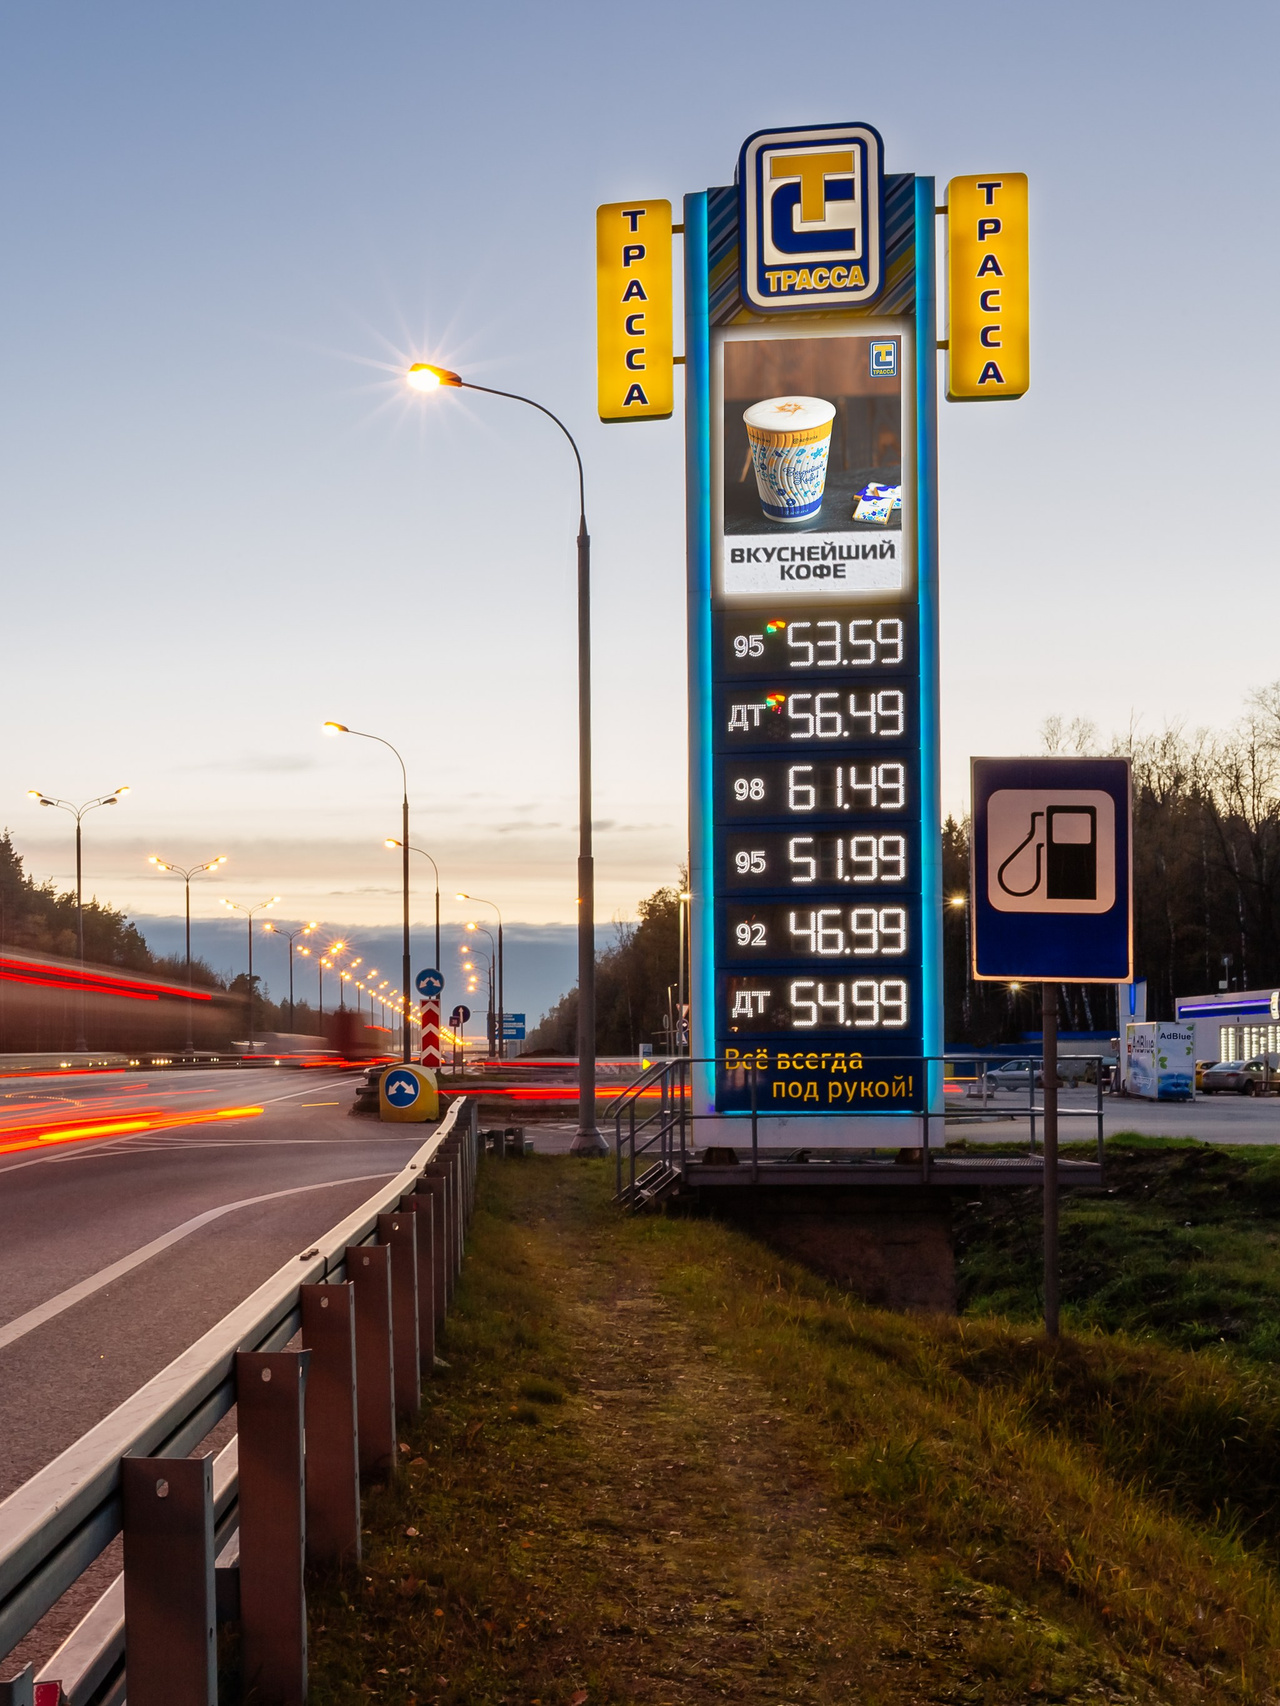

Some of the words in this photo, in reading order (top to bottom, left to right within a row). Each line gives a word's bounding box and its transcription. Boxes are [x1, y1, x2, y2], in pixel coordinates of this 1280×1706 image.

[765, 265, 865, 293] ТРАССА
[976, 181, 1005, 385] ТРАССА
[621, 209, 649, 407] ТРАССА
[730, 540, 896, 563] ВКУСНЕЙШИЙ
[780, 563, 846, 580] КОФЕ
[733, 634, 764, 657] 95
[787, 618, 903, 667] 53.59
[728, 704, 767, 731] ДТ
[788, 690, 904, 739] 56.49
[734, 778, 765, 801] 98
[788, 763, 905, 811] 61.49
[735, 850, 766, 874] 95
[789, 835, 905, 882] 51.99
[736, 923, 767, 946] 92
[789, 908, 906, 954] 46.99
[732, 991, 771, 1018] ДТ
[790, 980, 907, 1026] 54.99
[725, 1048, 768, 1070] Всё
[777, 1052, 863, 1073] всегда
[773, 1081, 819, 1101] под
[828, 1075, 913, 1103] рукой!
